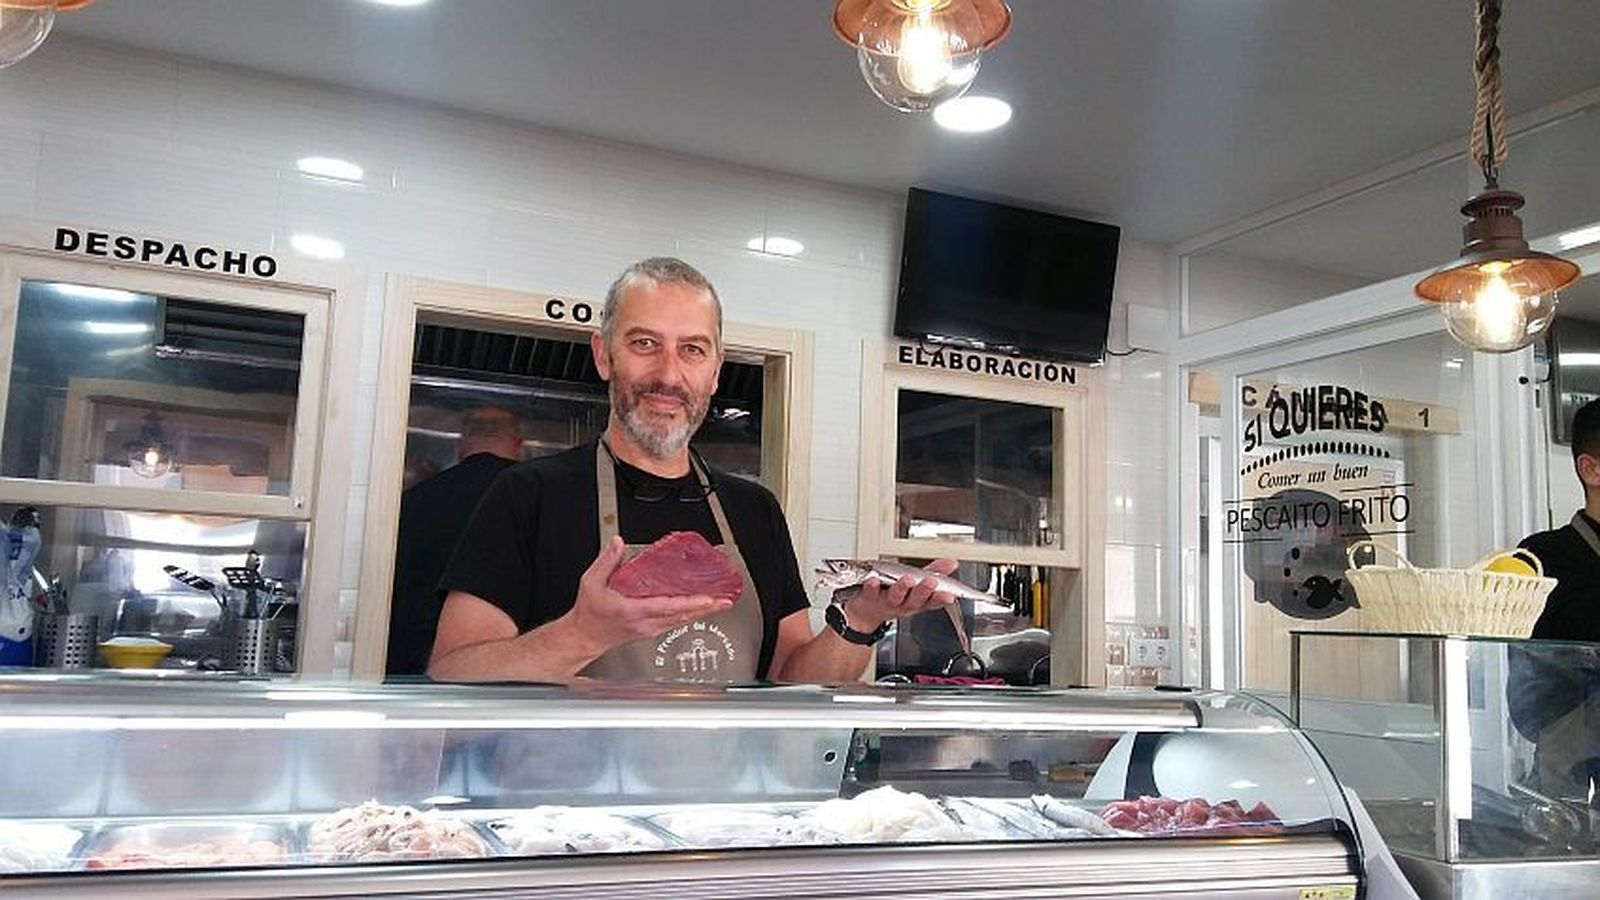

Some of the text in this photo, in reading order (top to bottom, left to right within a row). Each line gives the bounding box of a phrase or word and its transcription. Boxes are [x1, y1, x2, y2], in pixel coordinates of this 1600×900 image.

[55, 228, 277, 277] DESPACHO
[1244, 385, 1386, 452] SI QUIERES
[1258, 463, 1369, 489] Comer un buen
[1227, 494, 1410, 533] PESCAITO FRITO
